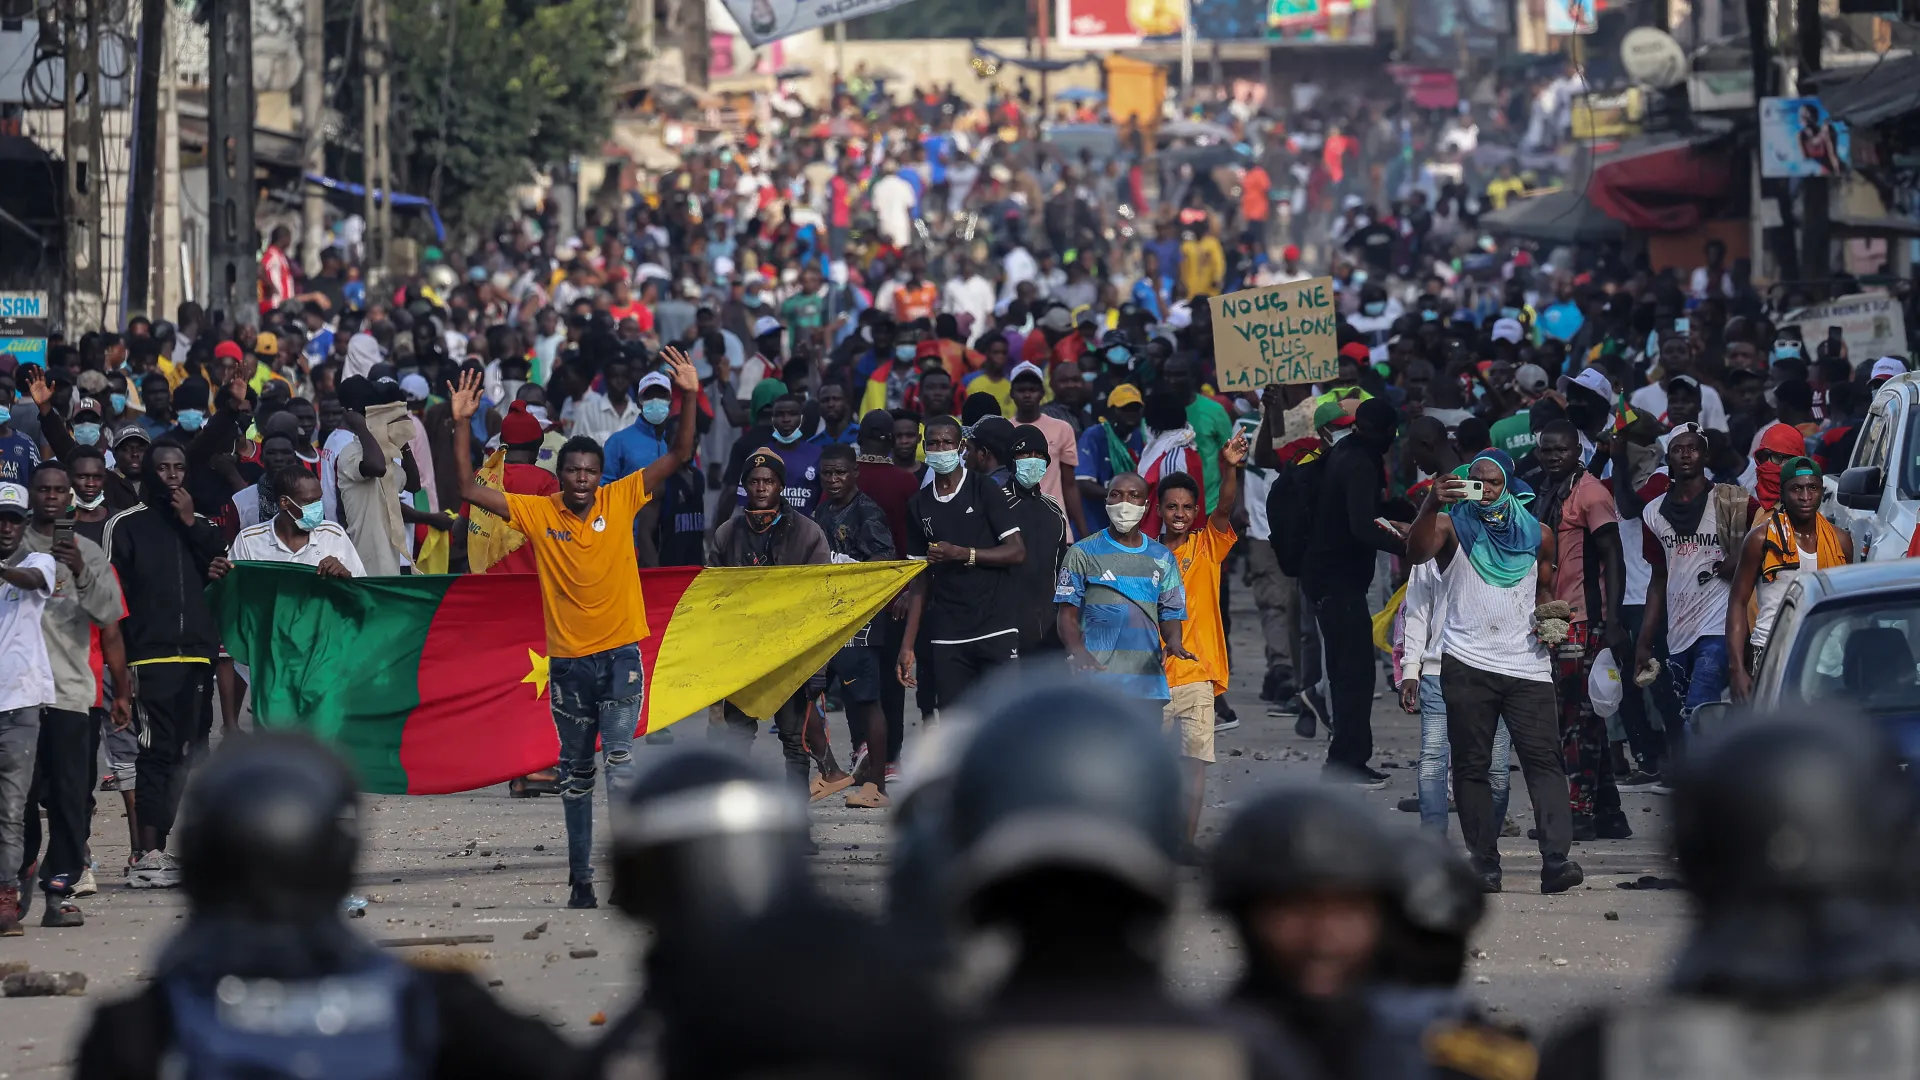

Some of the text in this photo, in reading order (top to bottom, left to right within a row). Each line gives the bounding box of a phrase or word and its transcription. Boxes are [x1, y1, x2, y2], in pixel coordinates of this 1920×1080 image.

[0, 298, 40, 317] SAM
[1298, 286, 1330, 308] NE
[1233, 314, 1337, 341] VOULONS
[1260, 338, 1306, 361] PLUS
